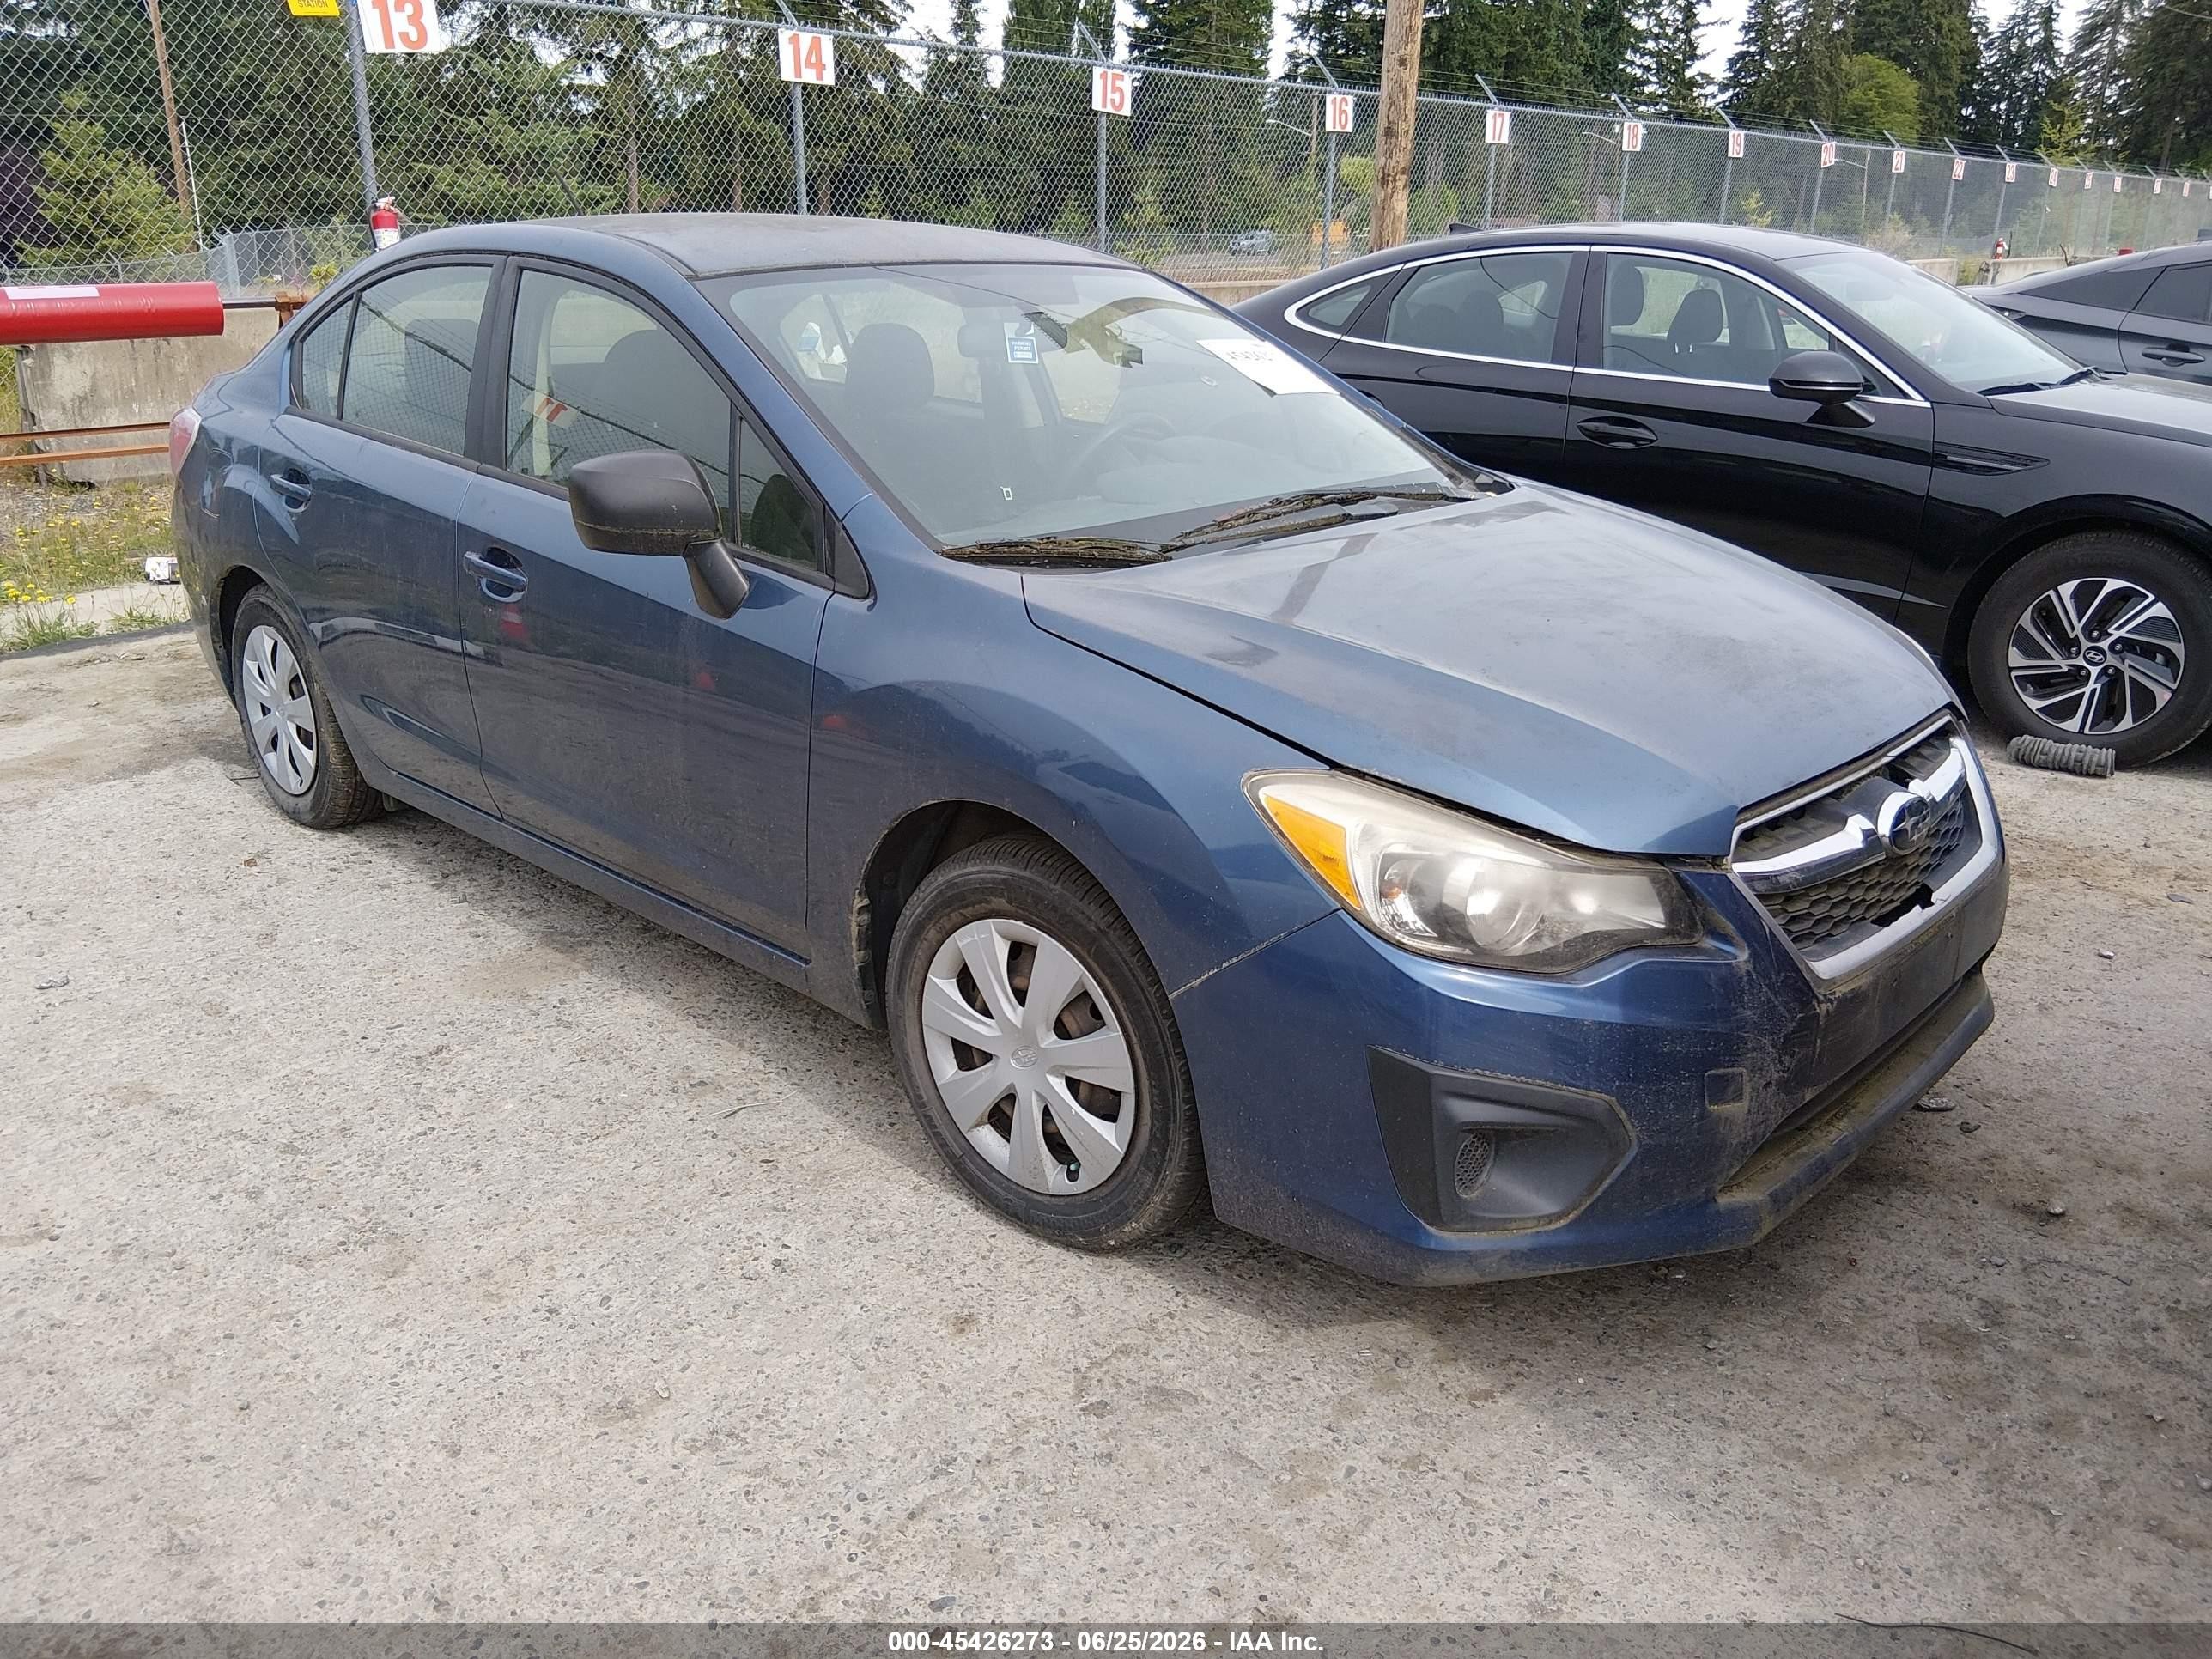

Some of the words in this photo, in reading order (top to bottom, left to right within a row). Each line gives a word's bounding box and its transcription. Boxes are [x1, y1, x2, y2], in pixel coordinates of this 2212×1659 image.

[372, 0, 428, 50] 13
[787, 32, 825, 82] 14
[1099, 70, 1126, 112] 15
[1330, 97, 1349, 130] 16
[1491, 112, 1504, 141] 17
[1626, 124, 1639, 149] 18
[1730, 133, 1742, 156] 19
[1822, 144, 1835, 166] 20
[1894, 152, 1905, 172] 21
[1954, 161, 1964, 179] 22
[2006, 164, 2015, 181] 23
